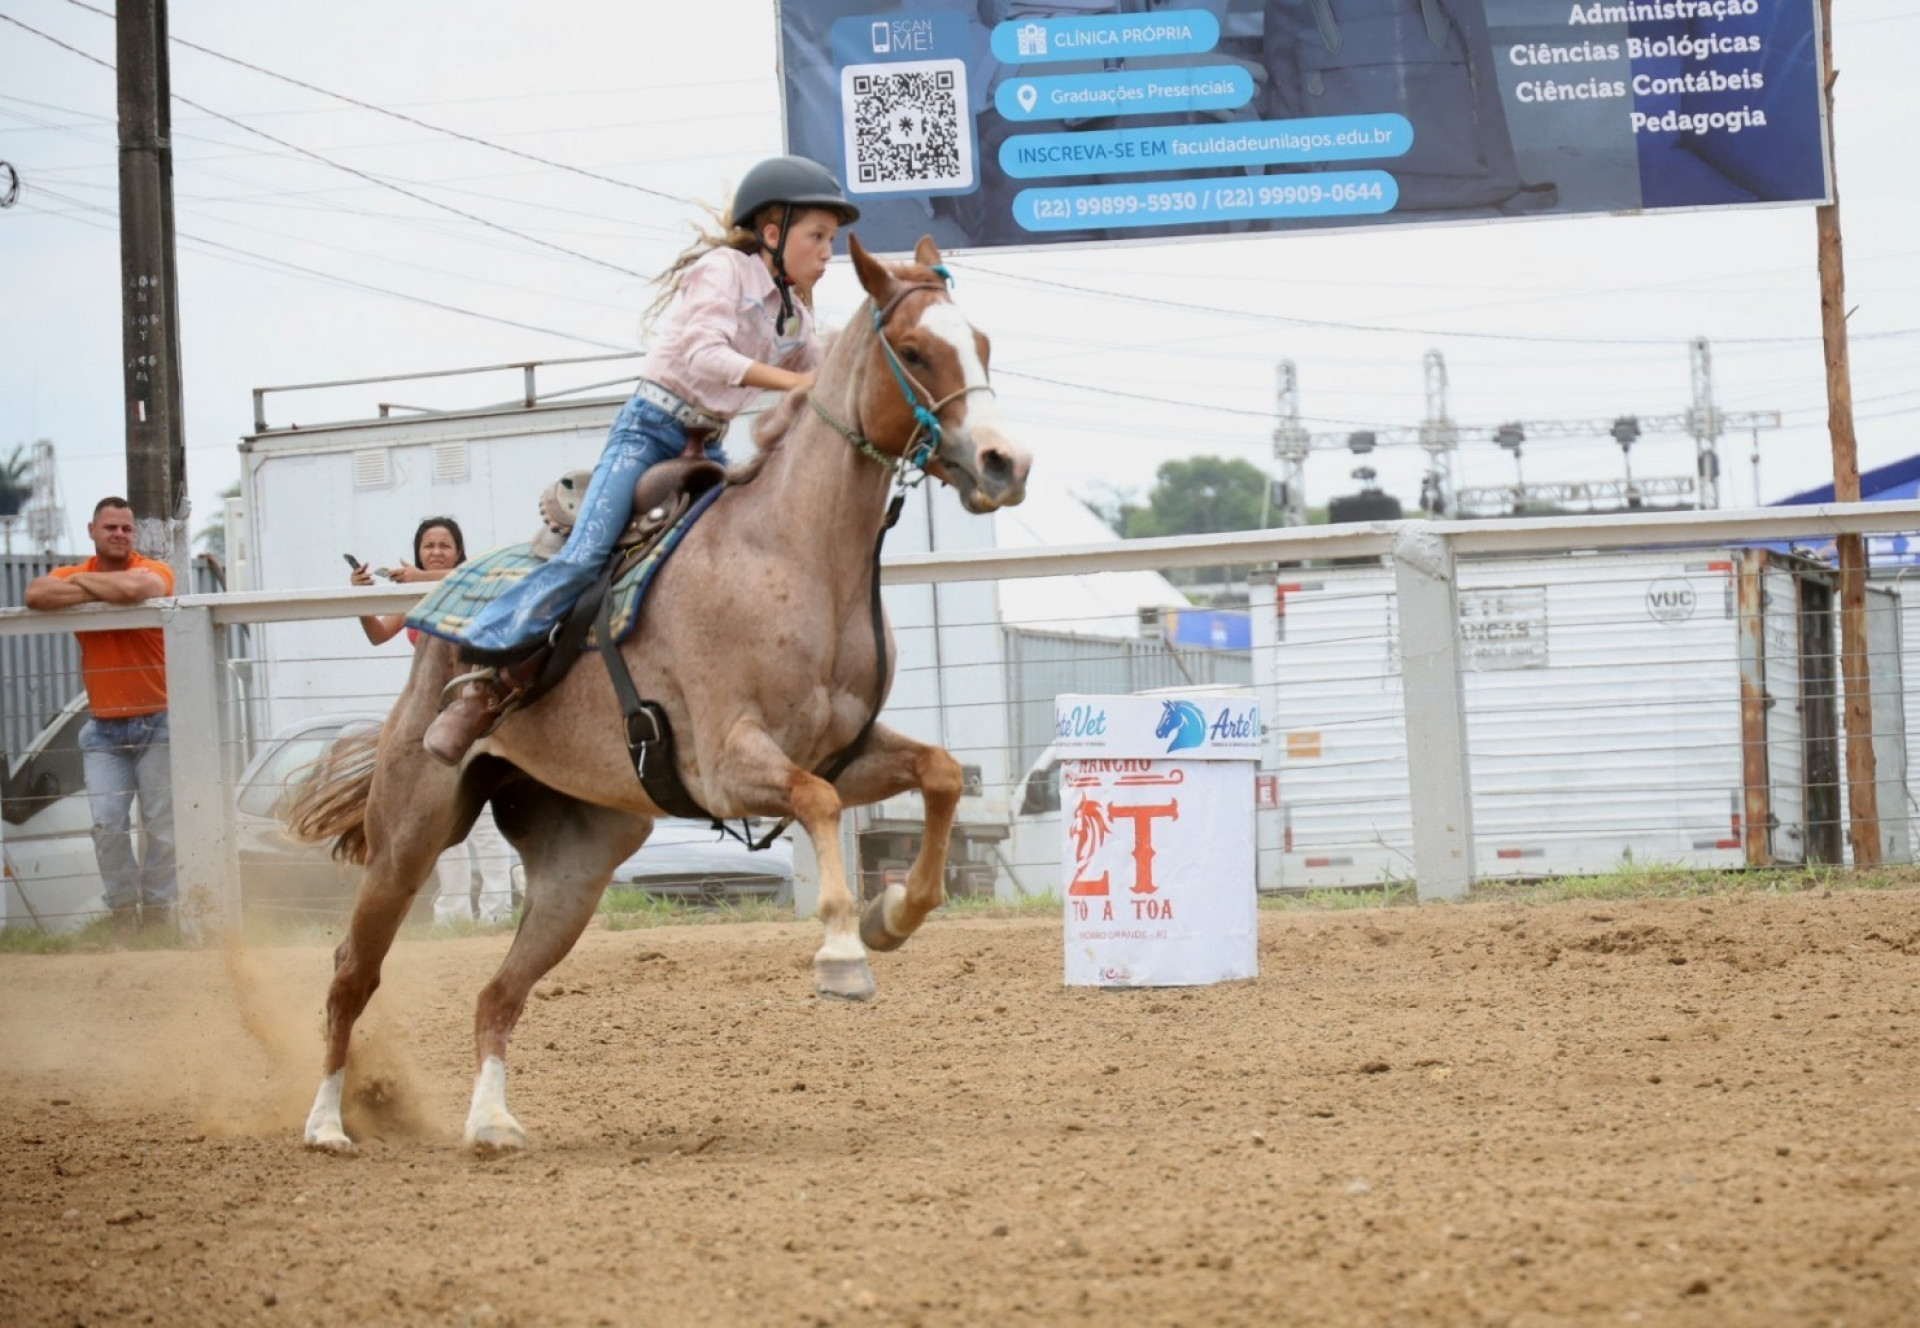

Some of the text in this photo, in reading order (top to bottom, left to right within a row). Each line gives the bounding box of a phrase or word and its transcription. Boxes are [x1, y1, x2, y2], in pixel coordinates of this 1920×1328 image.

[892, 19, 932, 33] SCAN
[1054, 25, 1192, 47] CLÍNICA PRÓPRIA
[893, 31, 933, 52] ME!
[1509, 33, 1761, 66] Ciências Biológicas
[1051, 79, 1235, 104] Graduações Presenciais
[1515, 68, 1764, 103] Ciências Contábeis
[1630, 105, 1767, 135] Pedagogia
[1018, 127, 1392, 163] INSCREVA-SE EM faculdadeunilagos.edu.br
[1033, 198, 1071, 219] (22)
[1076, 191, 1196, 215] 99899-5930
[1215, 187, 1254, 209] (22)
[1258, 182, 1383, 206] 99909-0644
[1650, 590, 1692, 607] VUC
[1103, 900, 1113, 920] A
[1130, 899, 1173, 920] TOA
[1108, 930, 1147, 940] GRANDE
